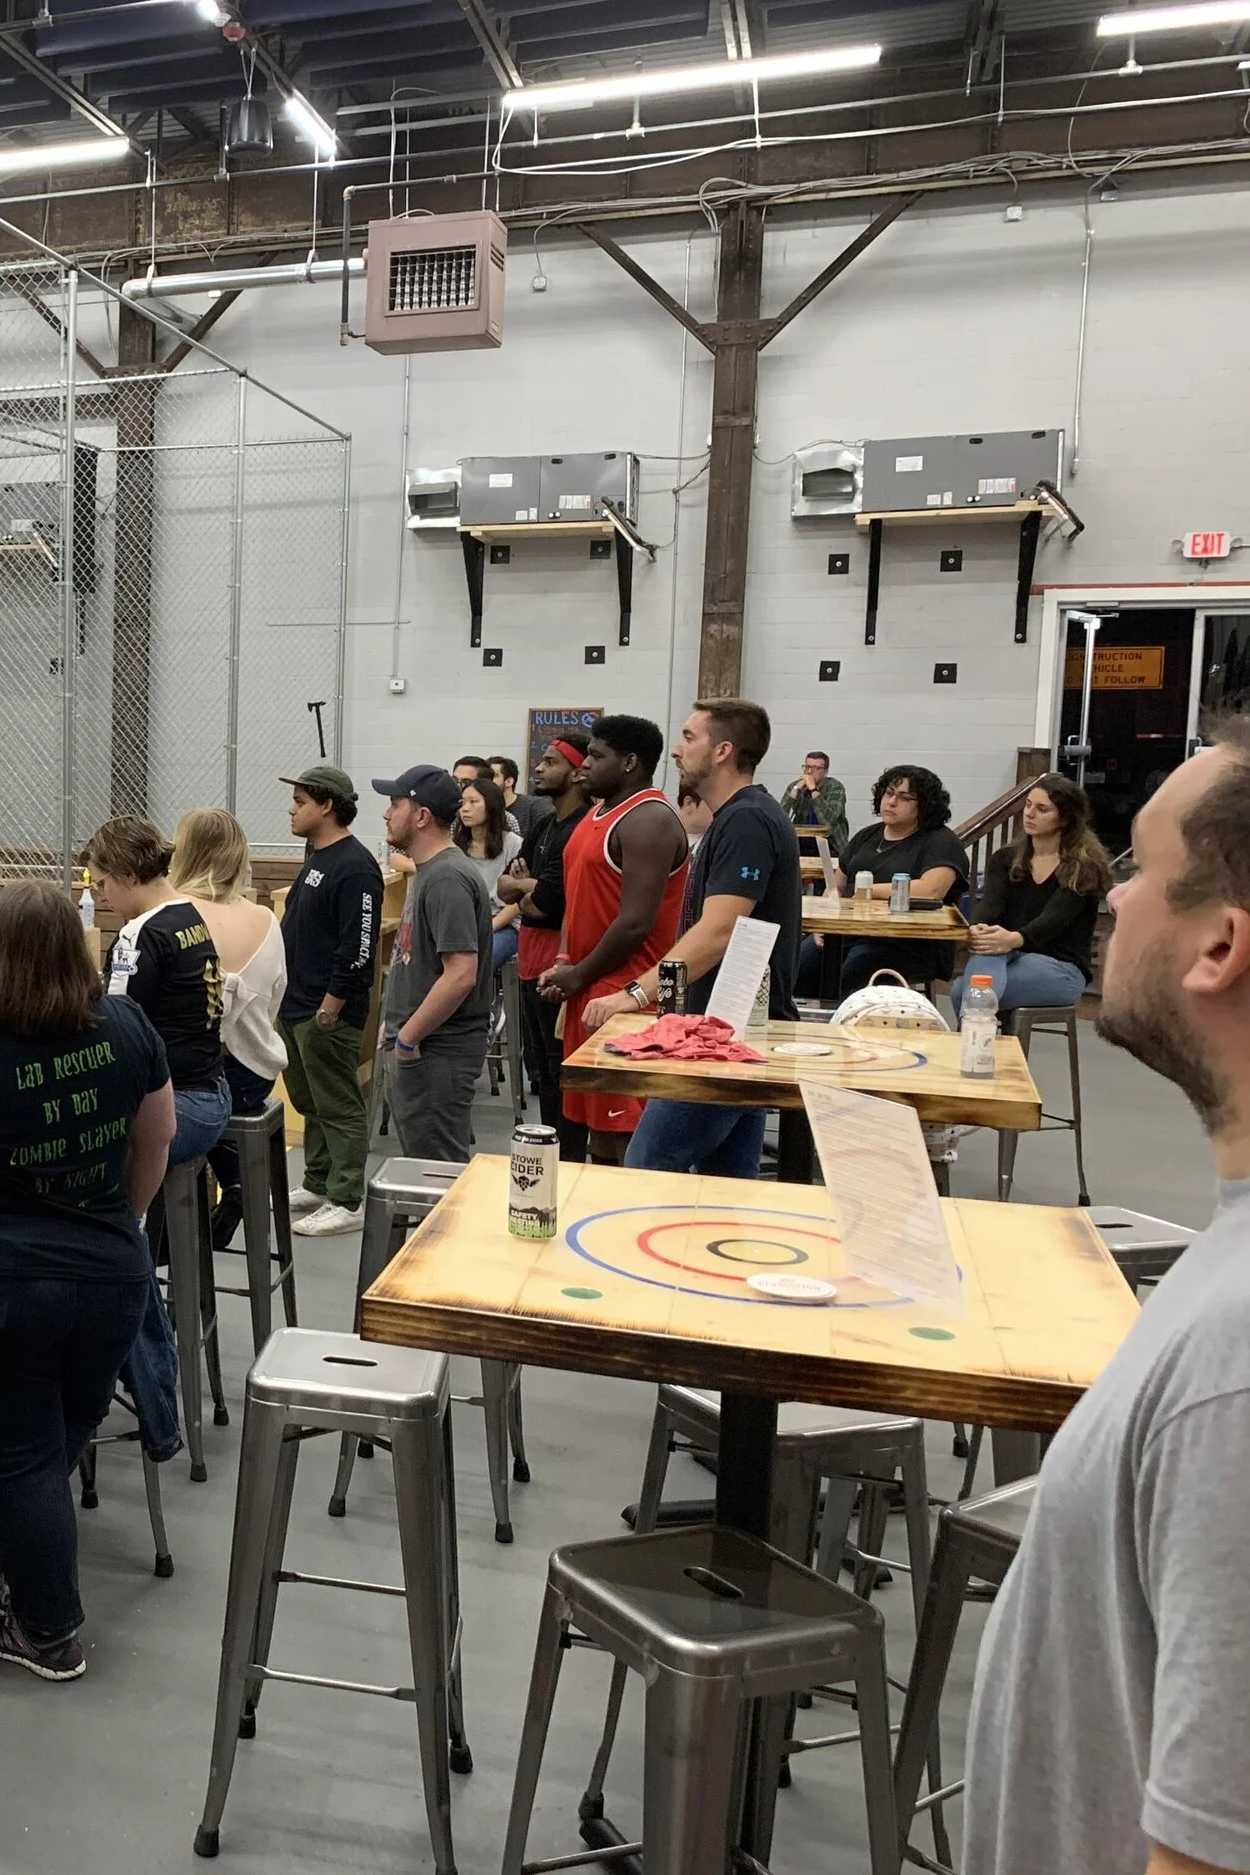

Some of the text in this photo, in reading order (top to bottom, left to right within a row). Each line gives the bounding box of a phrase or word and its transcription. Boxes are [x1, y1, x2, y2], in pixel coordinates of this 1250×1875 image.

[1191, 533, 1224, 555] EXIT
[1104, 675, 1146, 684] FOLLOW
[535, 711, 579, 725] RULES
[362, 892, 373, 912] SEE
[361, 913, 372, 933] YOU
[42, 1099, 61, 1125] BY
[511, 1153, 542, 1166] STOWE
[510, 1161, 544, 1176] CIDER
[510, 1209, 539, 1220] SAFETY
